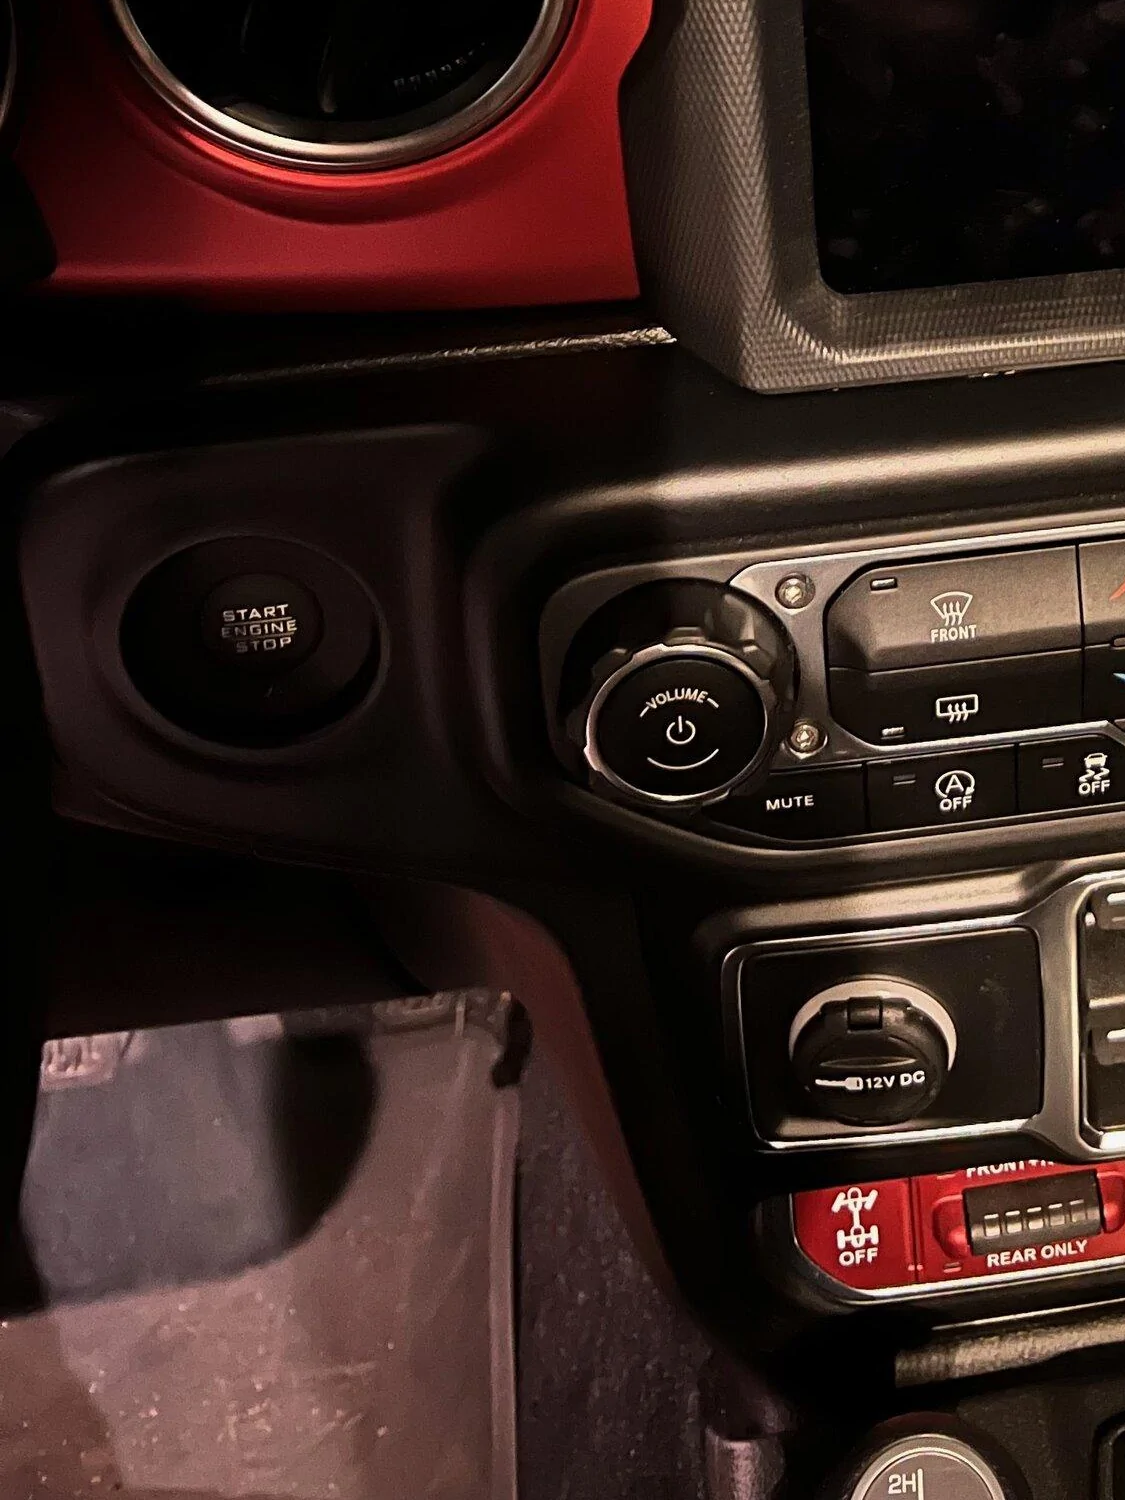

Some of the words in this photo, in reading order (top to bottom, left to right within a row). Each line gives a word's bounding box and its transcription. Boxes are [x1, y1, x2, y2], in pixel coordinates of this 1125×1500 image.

[222, 603, 290, 623] START
[221, 619, 298, 639] ENGINE
[930, 623, 977, 643] FRONT
[235, 636, 292, 654] STOP
[646, 687, 708, 712] VOLUME
[1078, 779, 1111, 796] OFF
[765, 794, 815, 811] MUTE
[939, 795, 973, 812] OFF
[866, 1075, 896, 1090] 12V
[900, 1070, 926, 1087] DC
[838, 1247, 880, 1267] OFF
[986, 1250, 1037, 1268] REAR
[1040, 1240, 1089, 1259] ONLY
[887, 1473, 917, 1495] 2H
